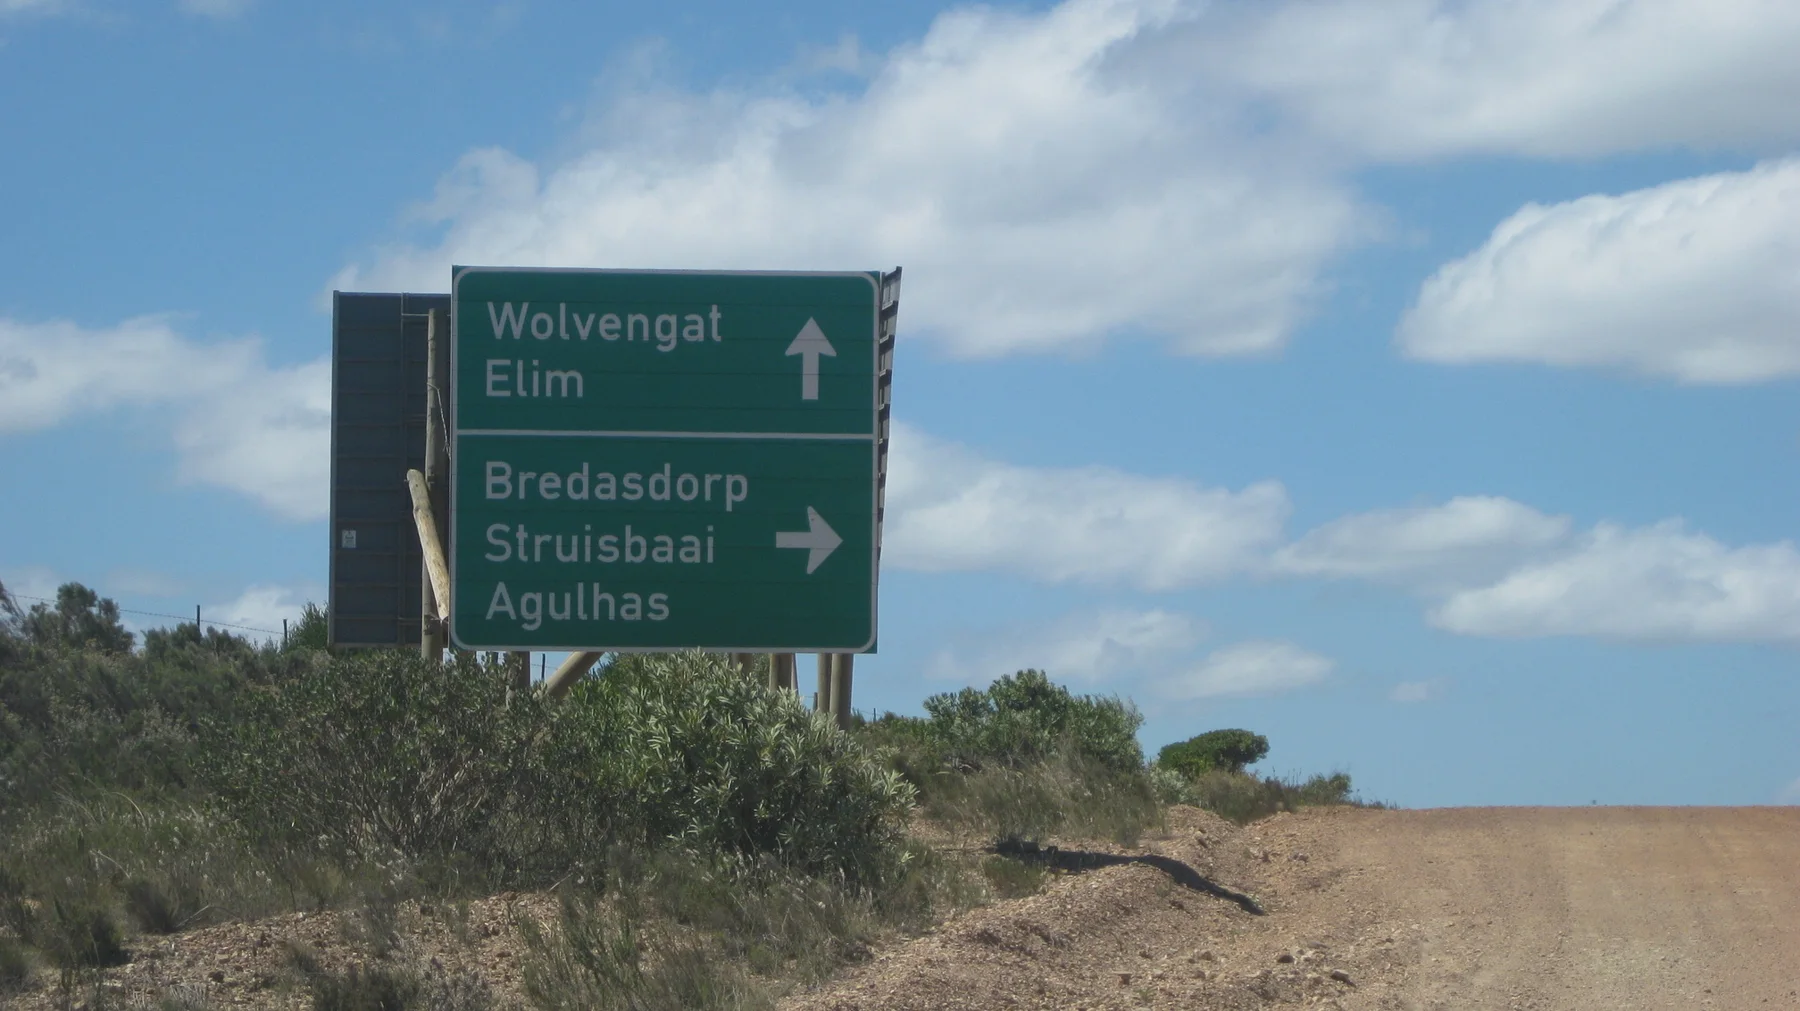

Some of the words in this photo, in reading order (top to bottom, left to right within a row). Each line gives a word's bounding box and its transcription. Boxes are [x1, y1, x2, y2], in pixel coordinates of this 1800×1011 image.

[487, 301, 722, 352] Wolvengat
[485, 359, 584, 398] Elim
[485, 461, 748, 512] Bredasdorp
[484, 523, 715, 563] Struisbaai
[485, 581, 670, 630] Agulhas
